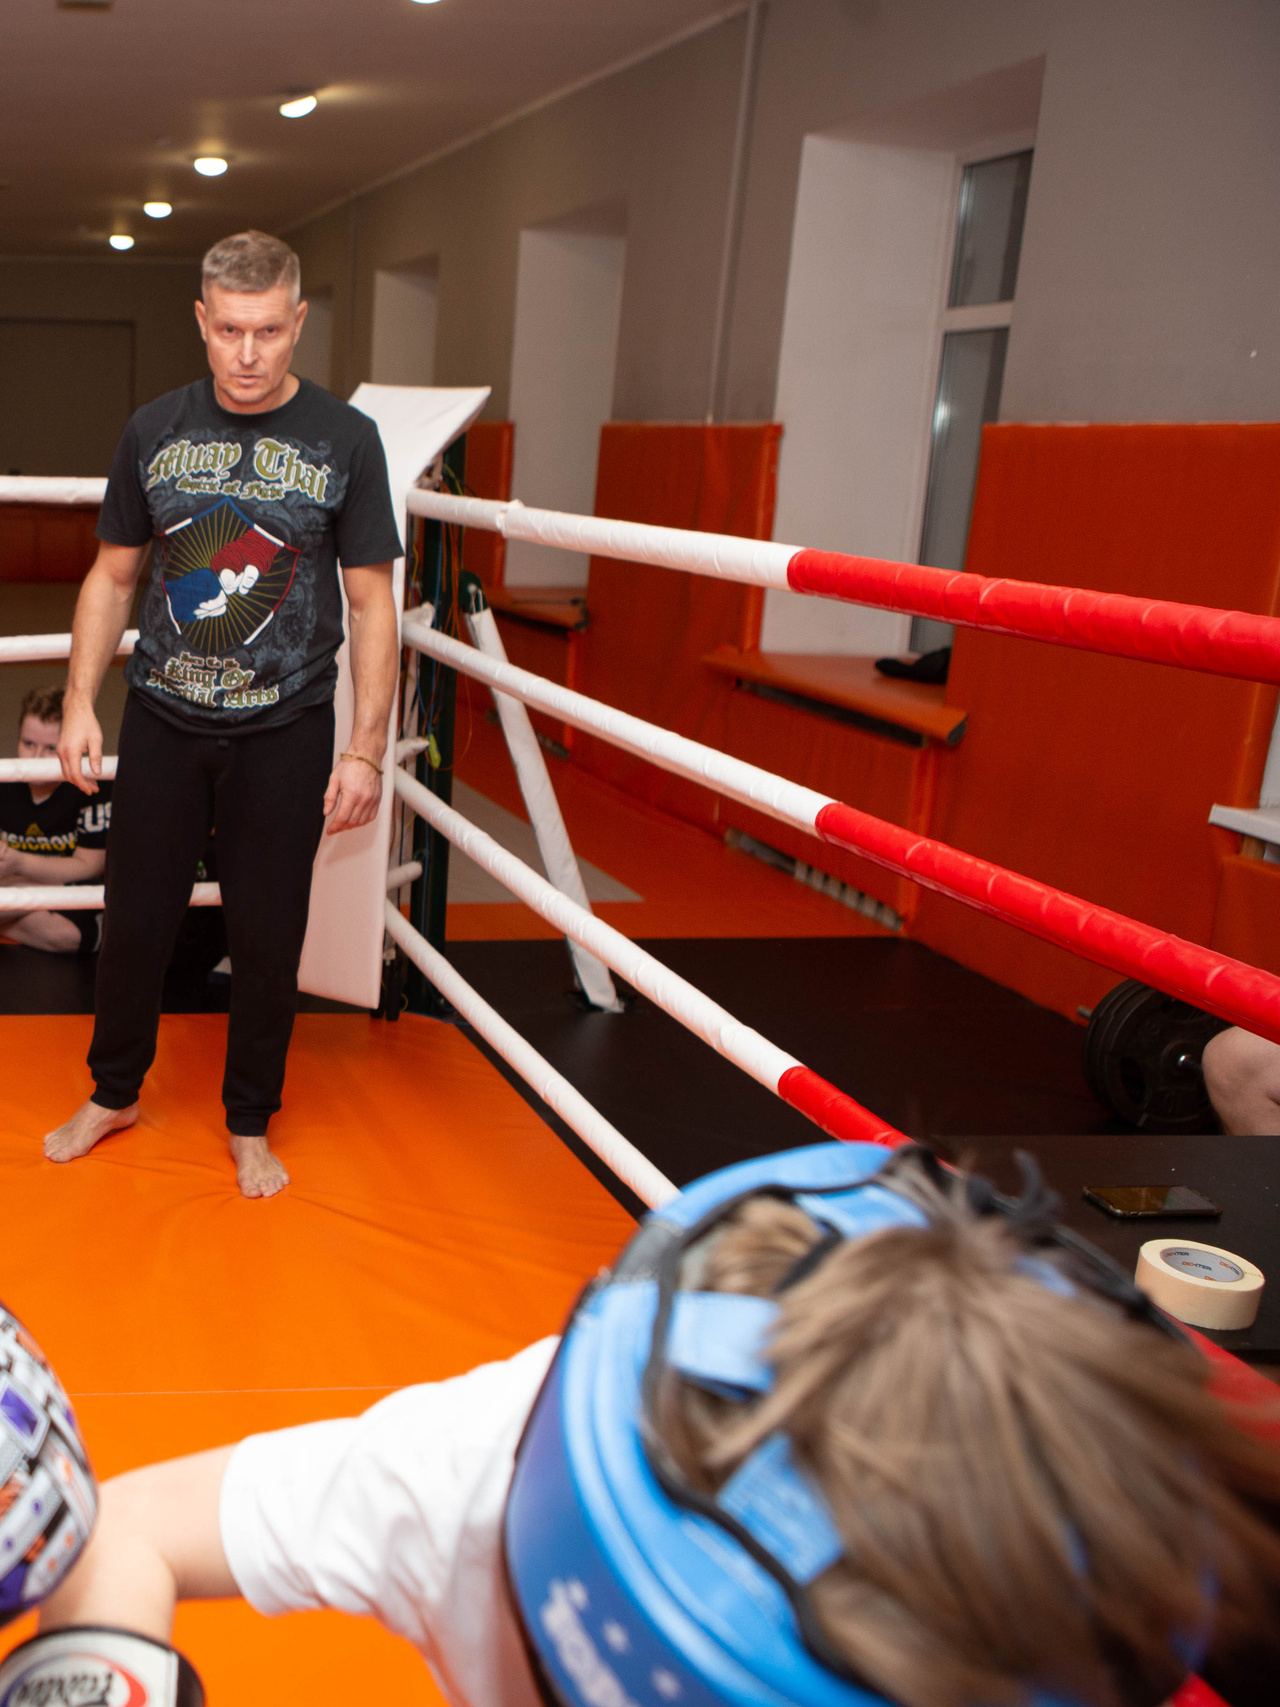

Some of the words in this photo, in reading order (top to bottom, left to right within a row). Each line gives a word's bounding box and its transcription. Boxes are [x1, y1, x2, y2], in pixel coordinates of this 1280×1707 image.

[147, 439, 242, 491] Muay
[253, 437, 331, 503] Thai
[1182, 1261, 1213, 1271] DEXTER
